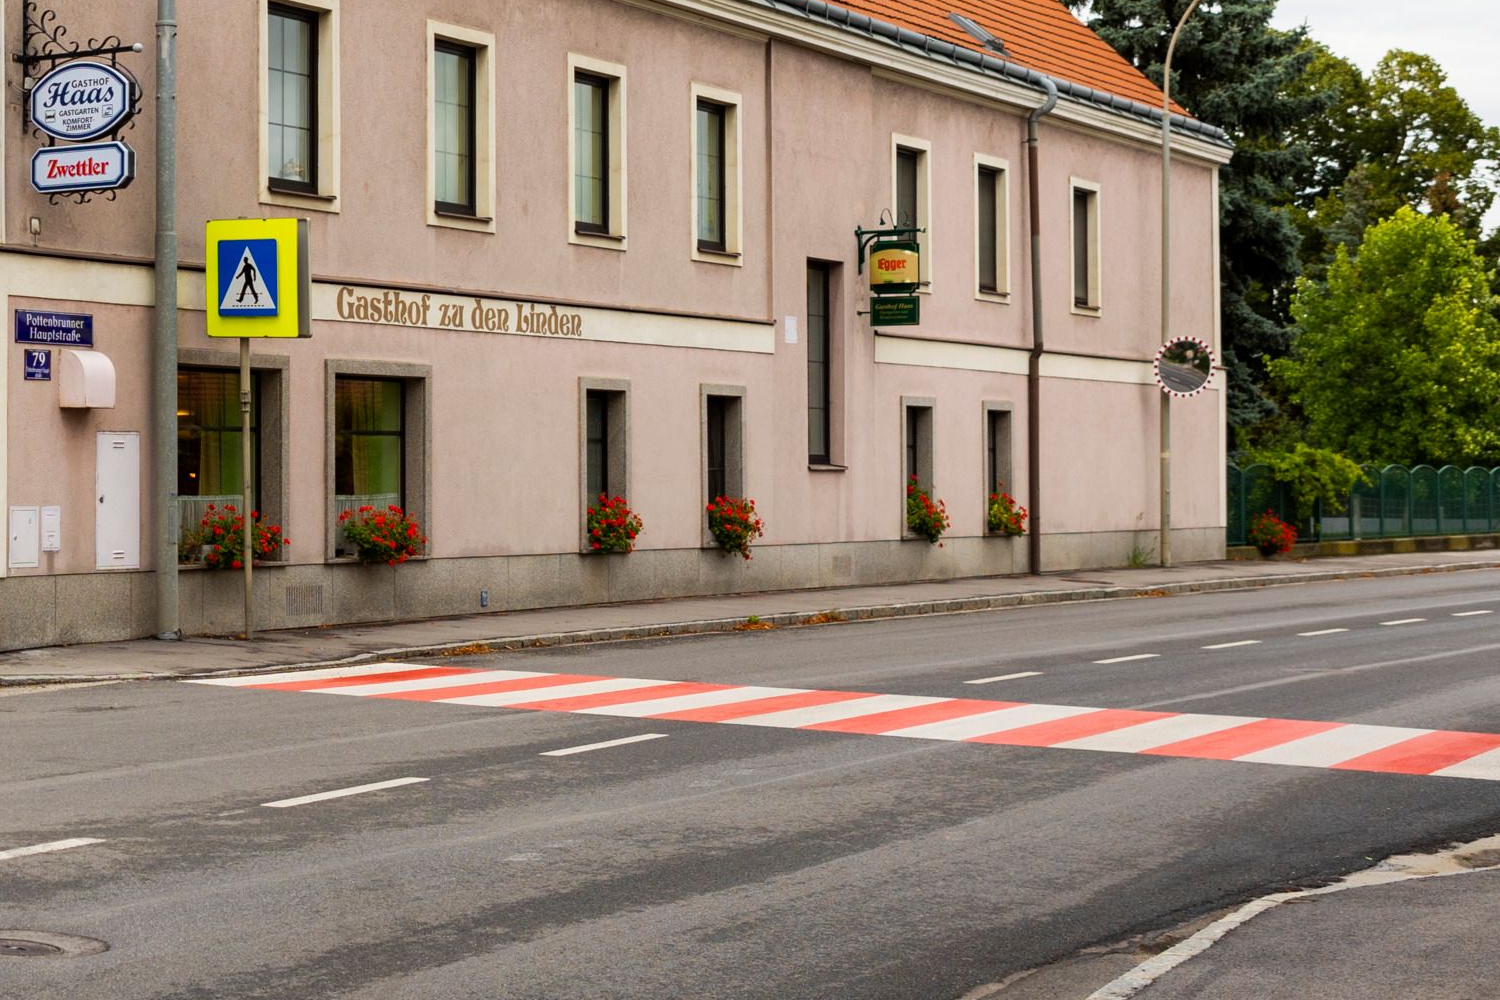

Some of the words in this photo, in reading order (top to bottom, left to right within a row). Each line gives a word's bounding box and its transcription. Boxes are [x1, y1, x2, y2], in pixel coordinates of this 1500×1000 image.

[71, 77, 110, 88] GASTHOF
[43, 81, 114, 108] Haas
[58, 107, 99, 117] GASTGARTEN
[65, 123, 91, 131] ZIMMER
[47, 157, 109, 179] Zwettler
[877, 258, 907, 271] Egger
[336, 286, 431, 326] Gasthof
[438, 303, 464, 328] zu
[471, 298, 509, 332] den
[515, 302, 582, 337] Linden
[26, 313, 85, 329] Pottenbrunner
[29, 327, 81, 342] Hauptstraße
[32, 352, 46, 366] 79
